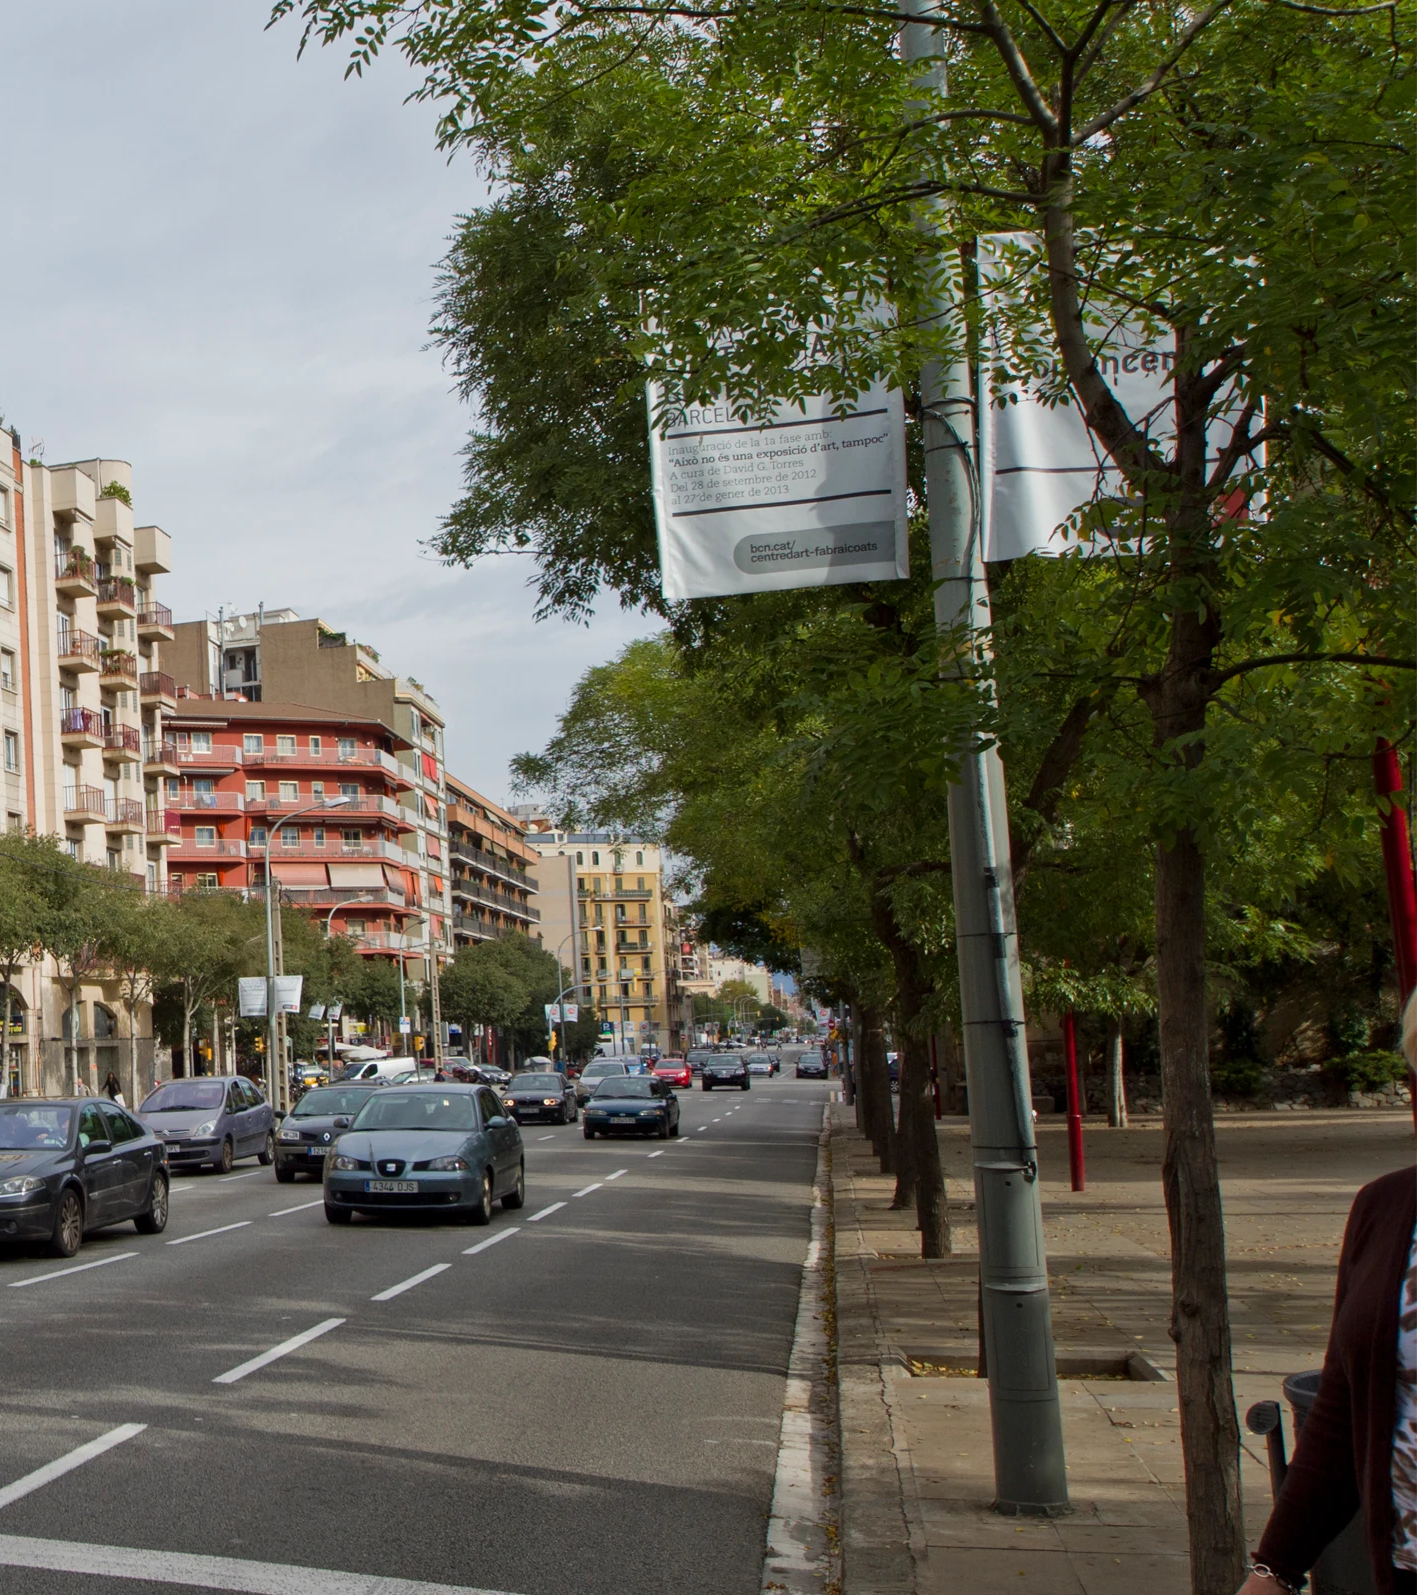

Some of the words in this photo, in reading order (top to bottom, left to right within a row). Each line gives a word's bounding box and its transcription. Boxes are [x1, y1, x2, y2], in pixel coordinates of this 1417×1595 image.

[666, 405, 769, 428] BARCEL
[668, 441, 732, 457] Inauguració
[734, 439, 748, 449] de
[750, 437, 760, 448] la
[764, 436, 776, 446] 1a
[779, 433, 802, 445] fase
[804, 430, 833, 442] amb:
[701, 455, 716, 465] no
[718, 453, 730, 463] és
[732, 451, 754, 462] una
[756, 444, 808, 460] exposició
[670, 471, 678, 481] A
[680, 469, 705, 480] cura
[707, 466, 721, 476] de
[723, 462, 754, 475] David
[756, 462, 768, 472] G.
[770, 459, 804, 471] Torres
[670, 481, 688, 493] Del
[691, 480, 704, 491] 28
[706, 478, 720, 489] de
[722, 474, 773, 488] setembre
[775, 472, 789, 482] de
[791, 469, 817, 481] 2012
[671, 495, 681, 506] al
[698, 491, 713, 503] de
[715, 489, 744, 503] gener
[747, 487, 761, 498] de
[764, 484, 789, 496] 2013
[750, 540, 796, 554] bcn.cat/
[750, 542, 878, 563] centredart-fabraicoats
[397, 1183, 414, 1191] DJS
